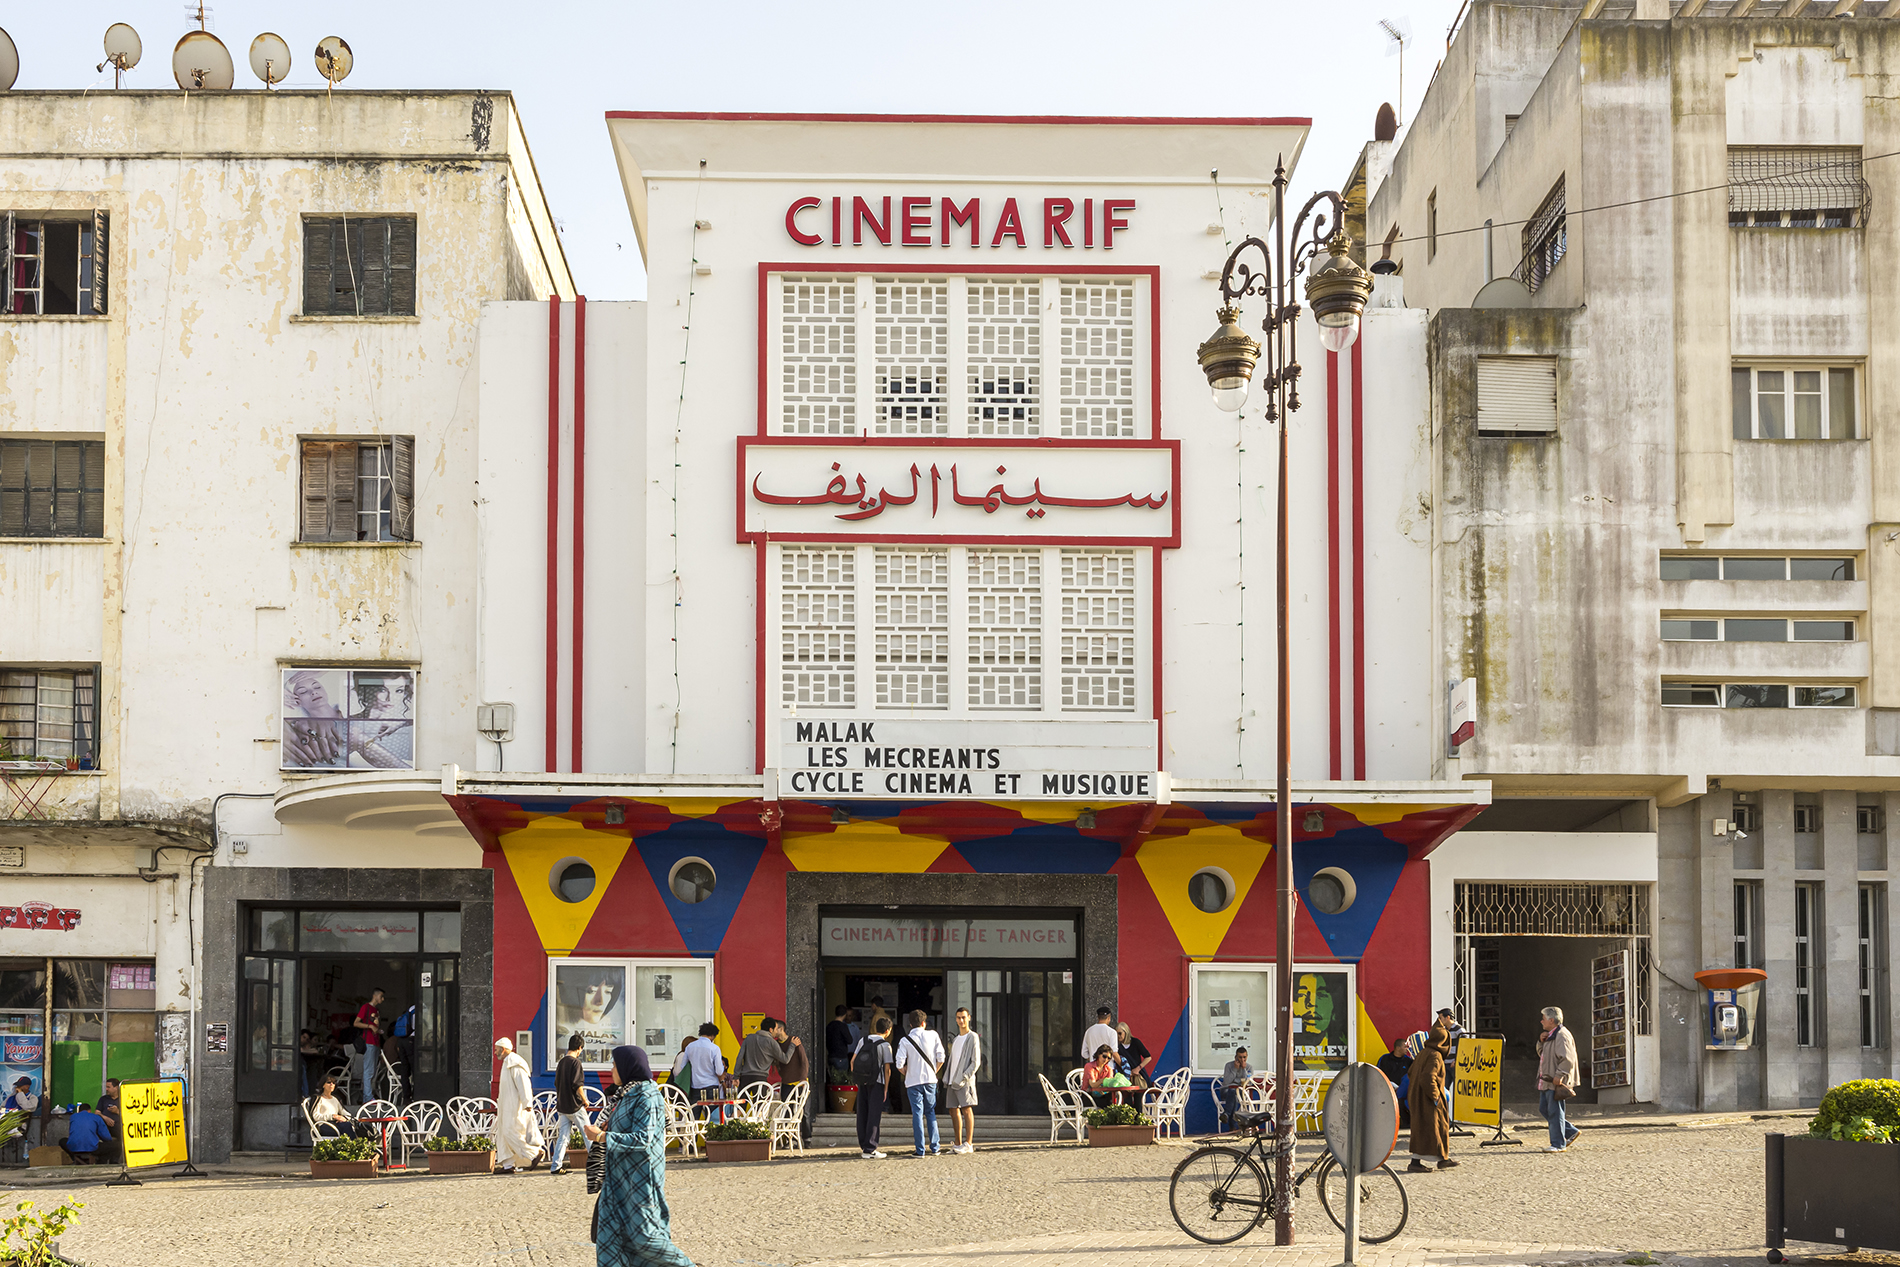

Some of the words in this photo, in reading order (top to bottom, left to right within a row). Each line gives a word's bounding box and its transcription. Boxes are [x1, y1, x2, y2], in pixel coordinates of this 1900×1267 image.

[785, 196, 1026, 248] CINEMA
[1043, 197, 1137, 250] RIF
[751, 461, 942, 522] الريف
[949, 462, 1169, 519] سينما
[796, 722, 875, 743] MALAK
[807, 747, 848, 768] LES
[864, 747, 1001, 770] MECREANTS
[791, 772, 864, 794] CYCLE
[885, 773, 973, 795] CINEMA
[994, 774, 1021, 795] ET
[1042, 774, 1149, 796] MUSIQUE
[830, 927, 960, 943] CINEMATHEQUE
[968, 928, 987, 943] DE
[996, 928, 1067, 944] TANGER
[5, 1042, 43, 1060] Yawmy
[1293, 1045, 1348, 1057] ARLEY
[1457, 1079, 1482, 1097] CINEMA
[1484, 1081, 1496, 1098] RIF
[127, 1121, 164, 1139] CINEMA
[165, 1120, 181, 1137] RIF
